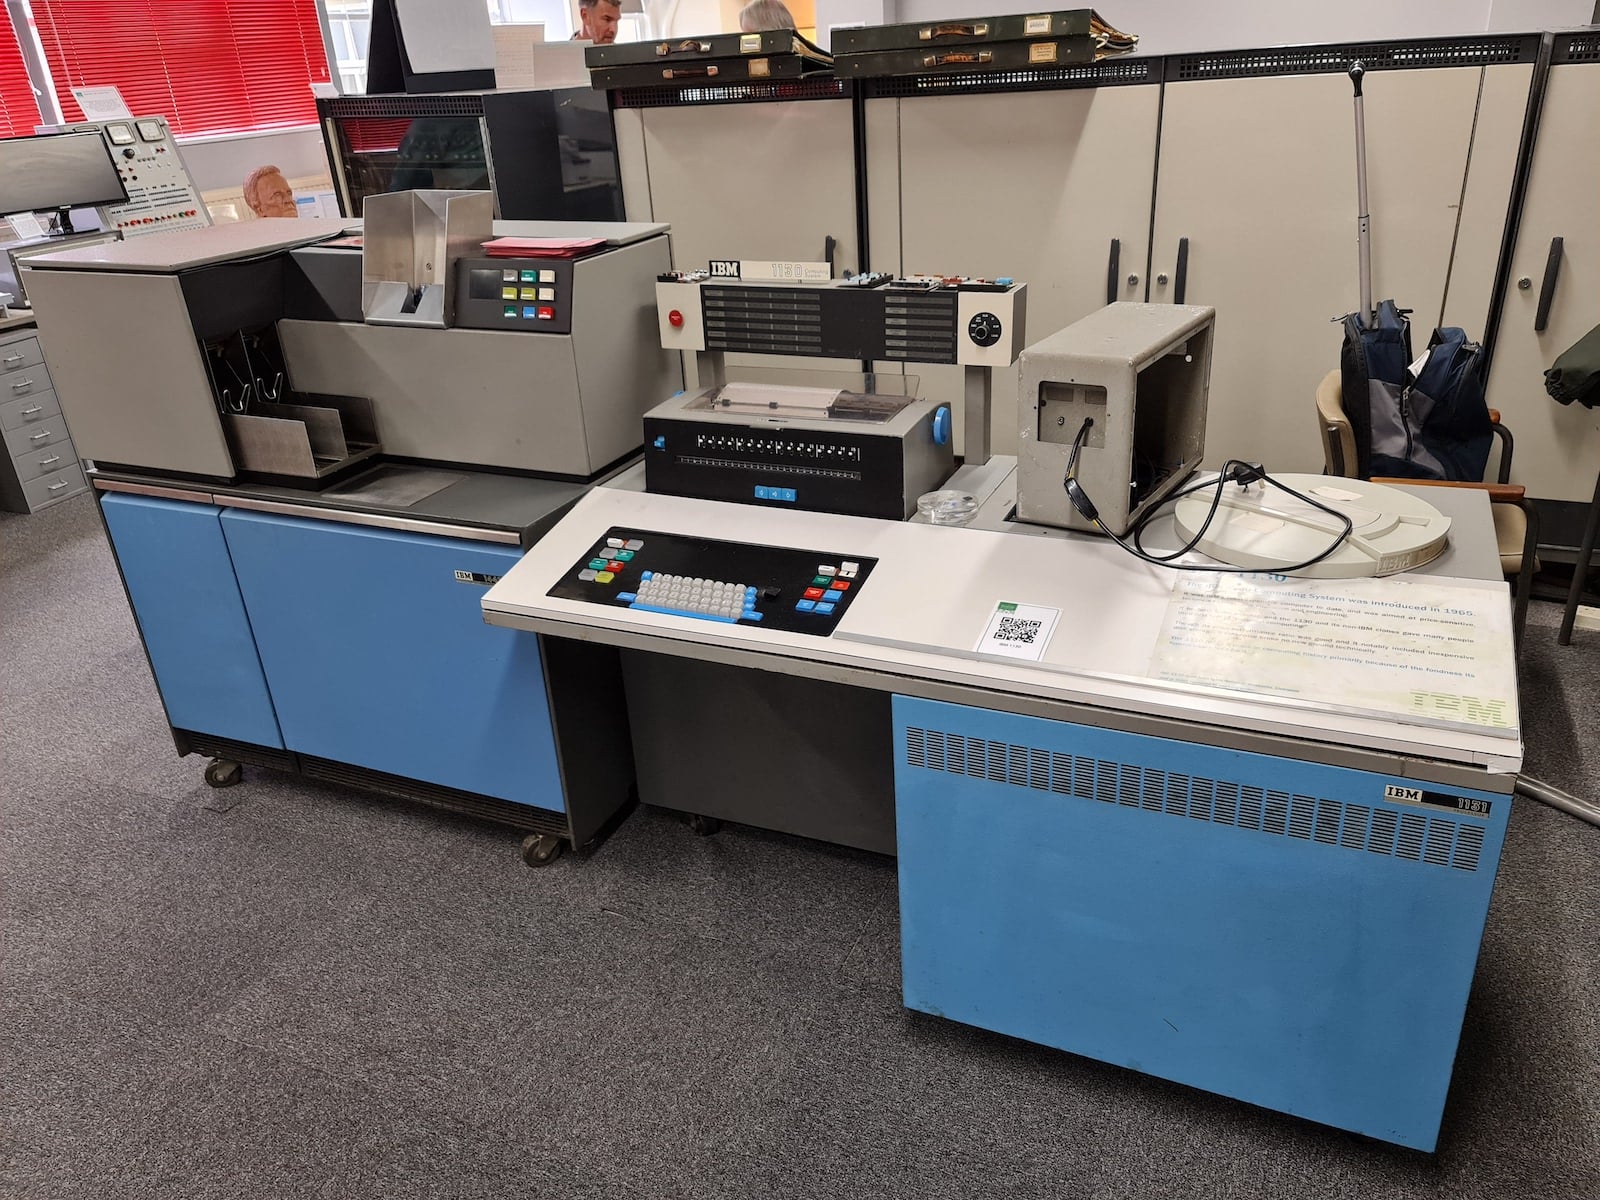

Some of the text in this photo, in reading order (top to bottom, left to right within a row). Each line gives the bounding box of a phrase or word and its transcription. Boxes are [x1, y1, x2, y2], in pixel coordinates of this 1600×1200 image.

[711, 261, 803, 278] IBM 1130
[455, 571, 472, 580] IBM
[1309, 593, 1345, 602] System
[1371, 600, 1427, 611] introduced
[1392, 646, 1425, 654] included
[1428, 651, 1475, 660] inexpensive
[1426, 667, 1463, 676] fondness
[1408, 689, 1507, 727] IBM
[1386, 786, 1420, 800] IBM
[1457, 797, 1488, 813] 1131
